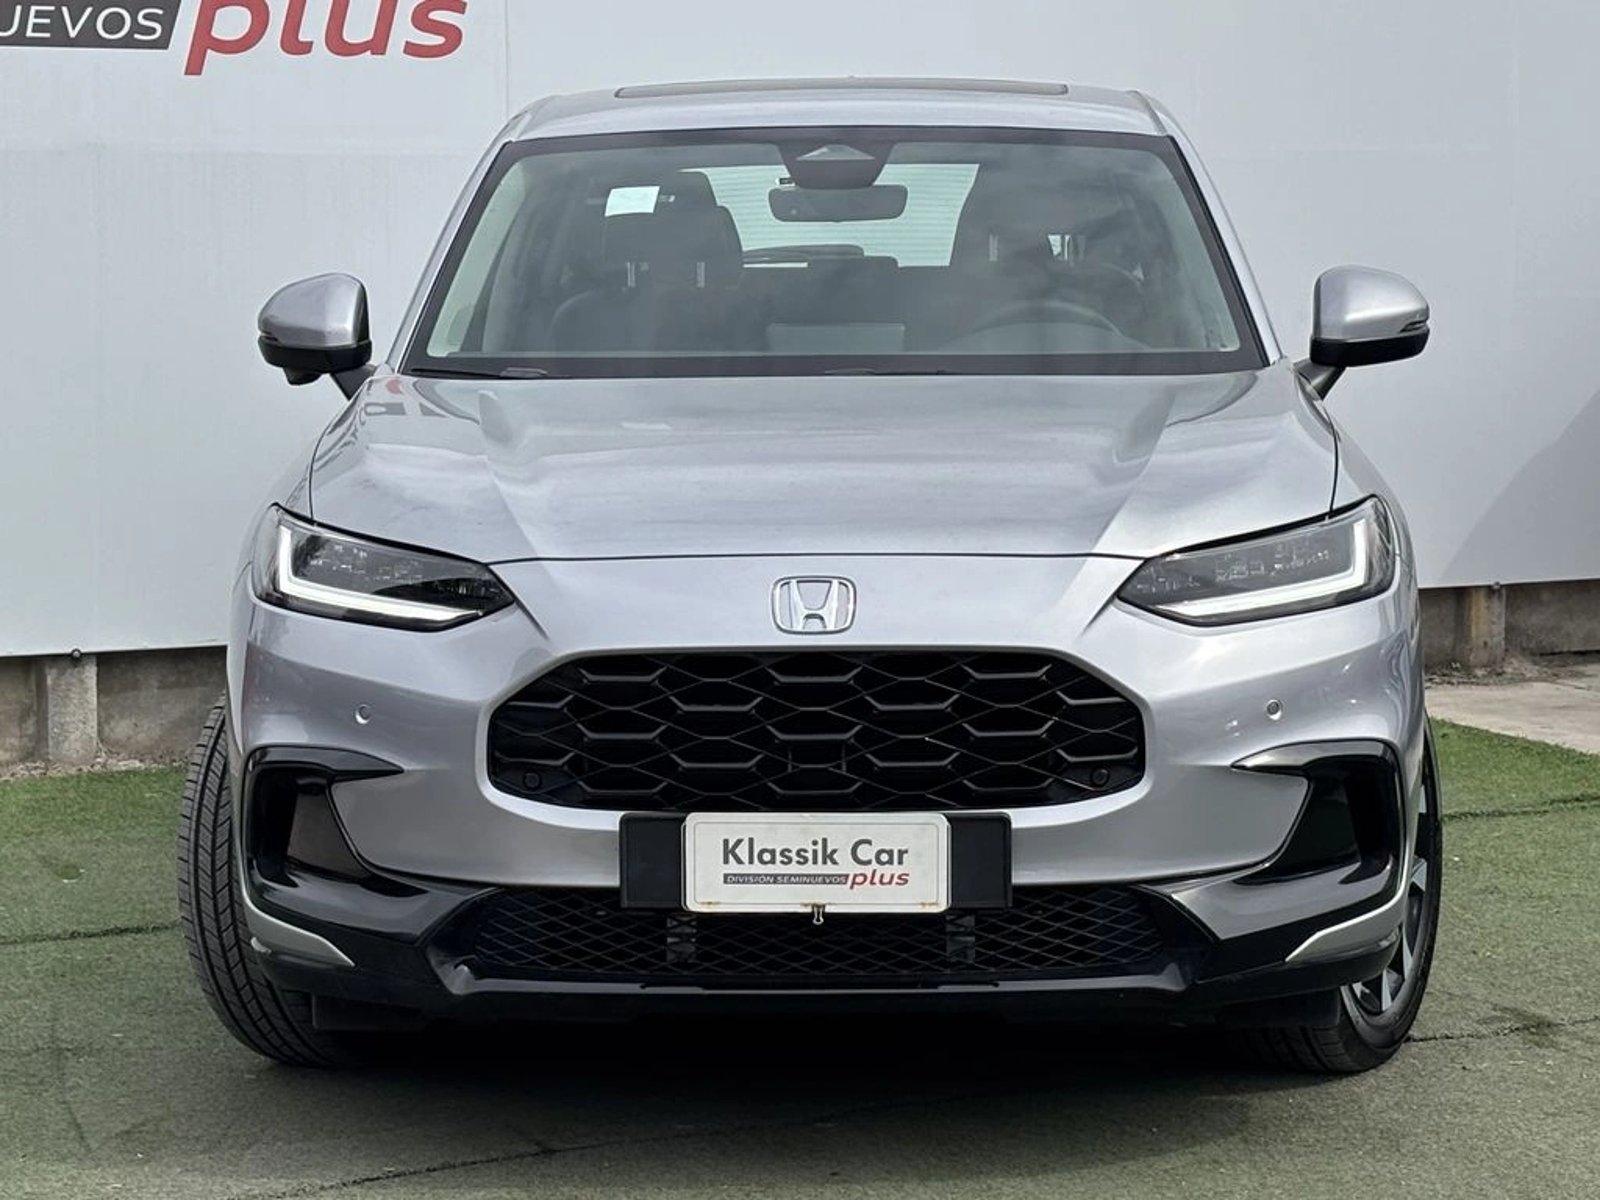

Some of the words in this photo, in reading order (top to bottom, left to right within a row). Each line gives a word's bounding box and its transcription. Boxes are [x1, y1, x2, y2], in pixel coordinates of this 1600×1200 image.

[184, 0, 468, 75] plus
[722, 837, 839, 865] Klassik
[850, 838, 908, 866] Car
[776, 875, 847, 885] SEMINUEVOS
[849, 869, 910, 889] plus
